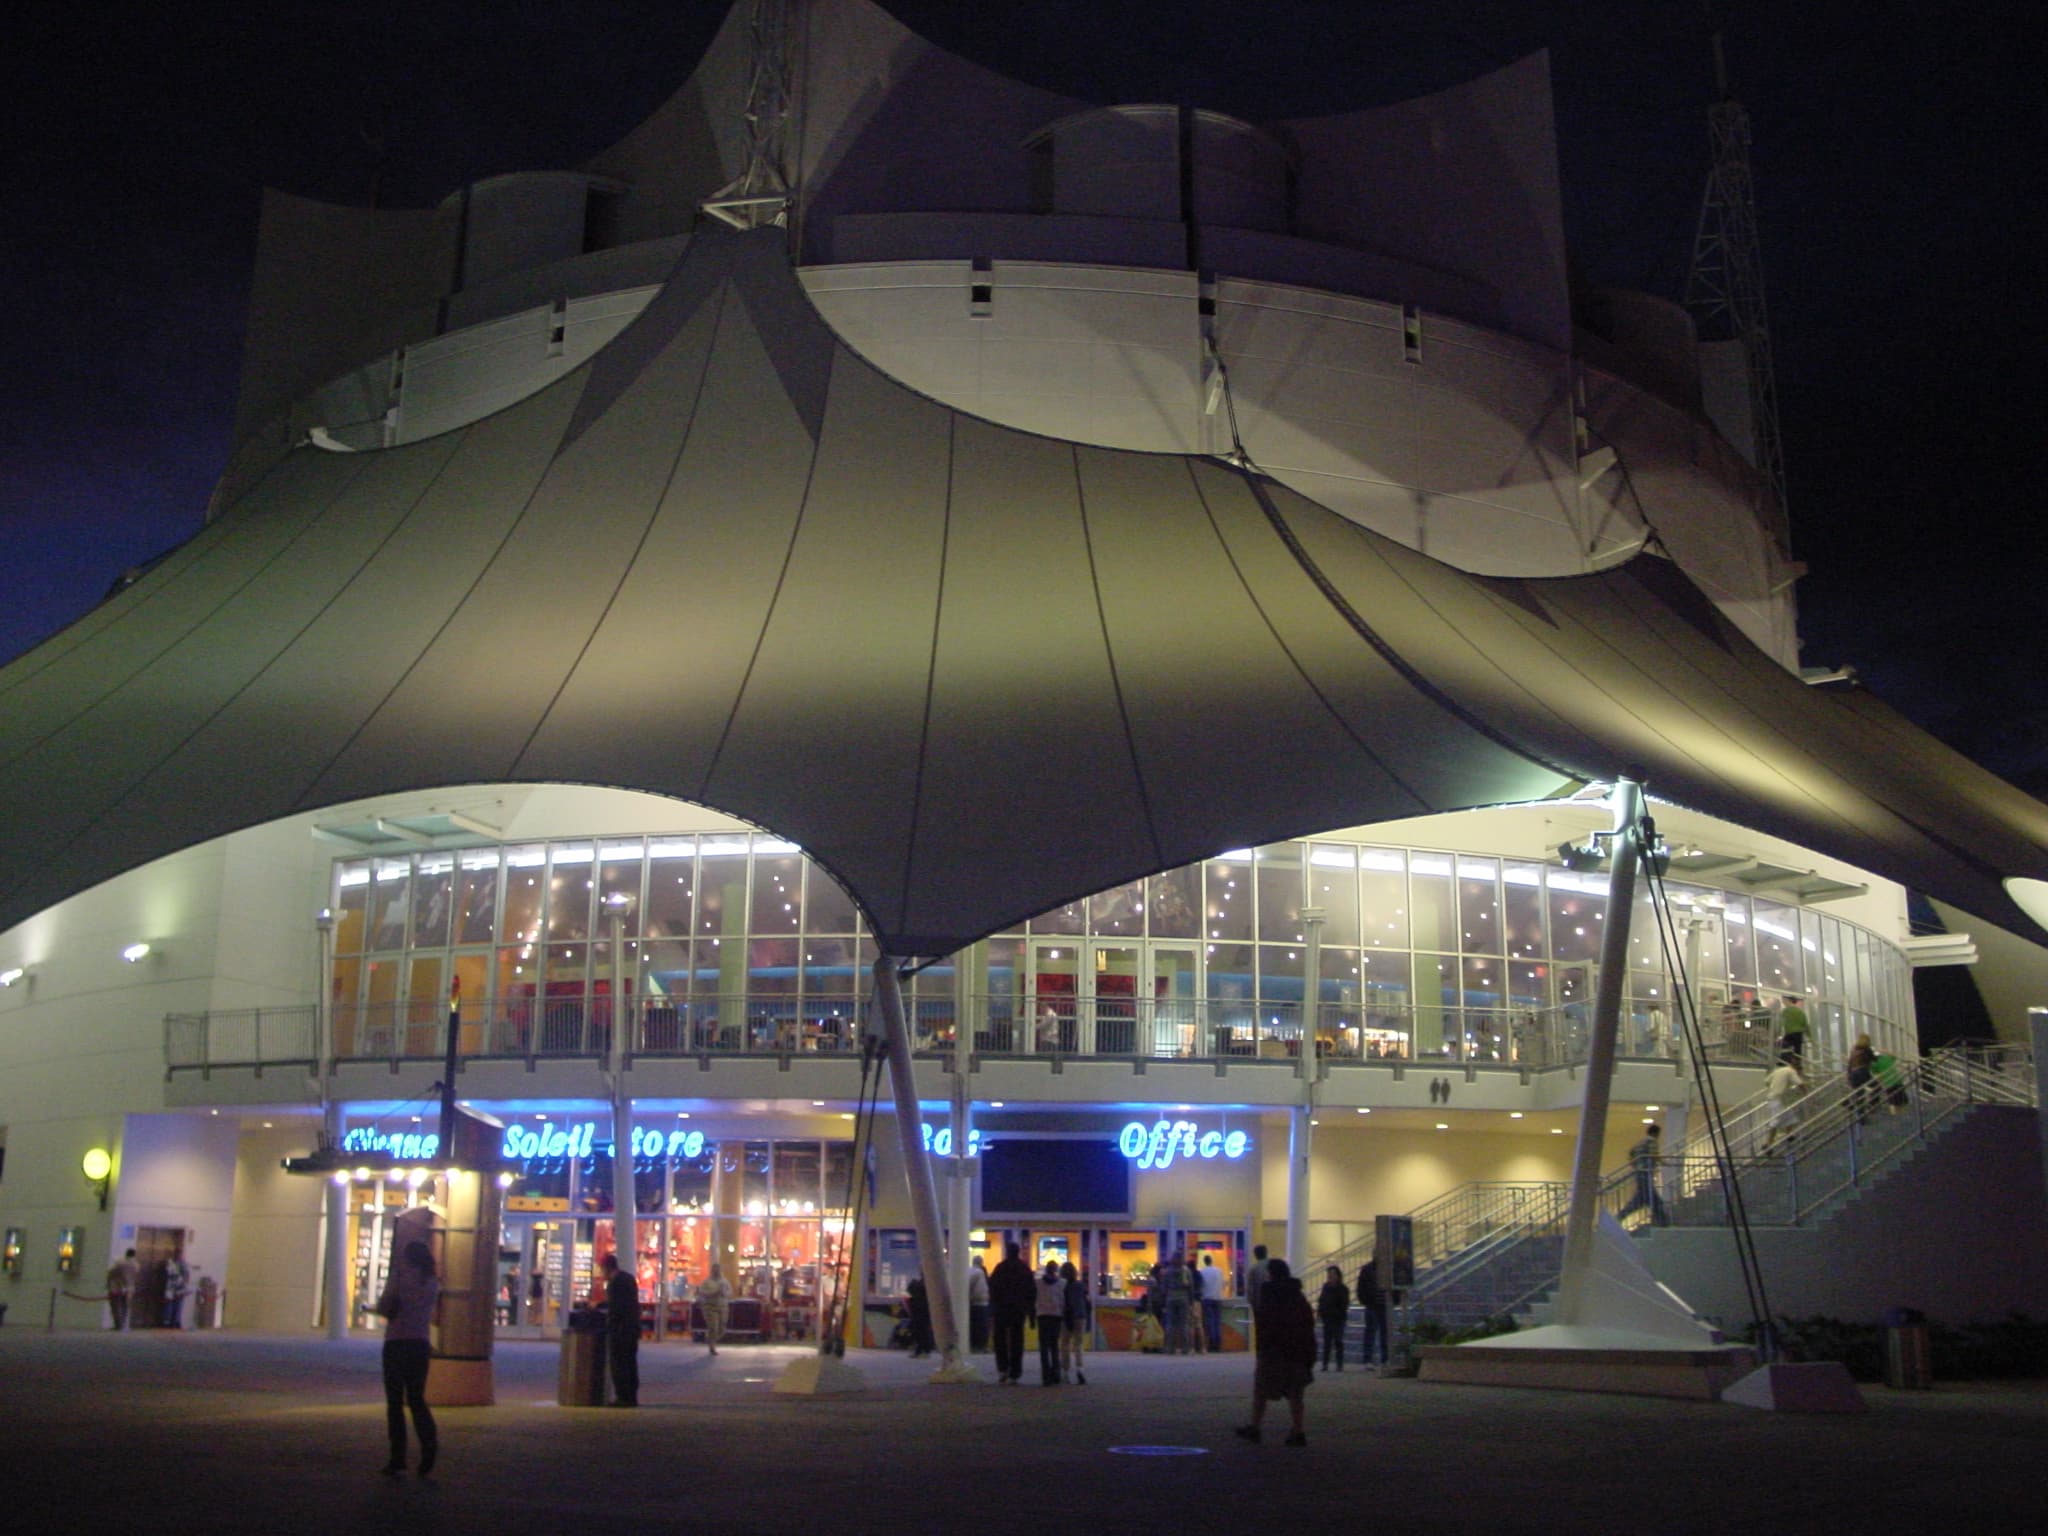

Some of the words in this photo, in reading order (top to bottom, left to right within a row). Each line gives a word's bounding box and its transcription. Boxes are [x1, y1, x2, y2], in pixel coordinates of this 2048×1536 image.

[502, 1122, 596, 1158] Soleil
[608, 1126, 705, 1159] tore
[1119, 1119, 1248, 1170] Office
